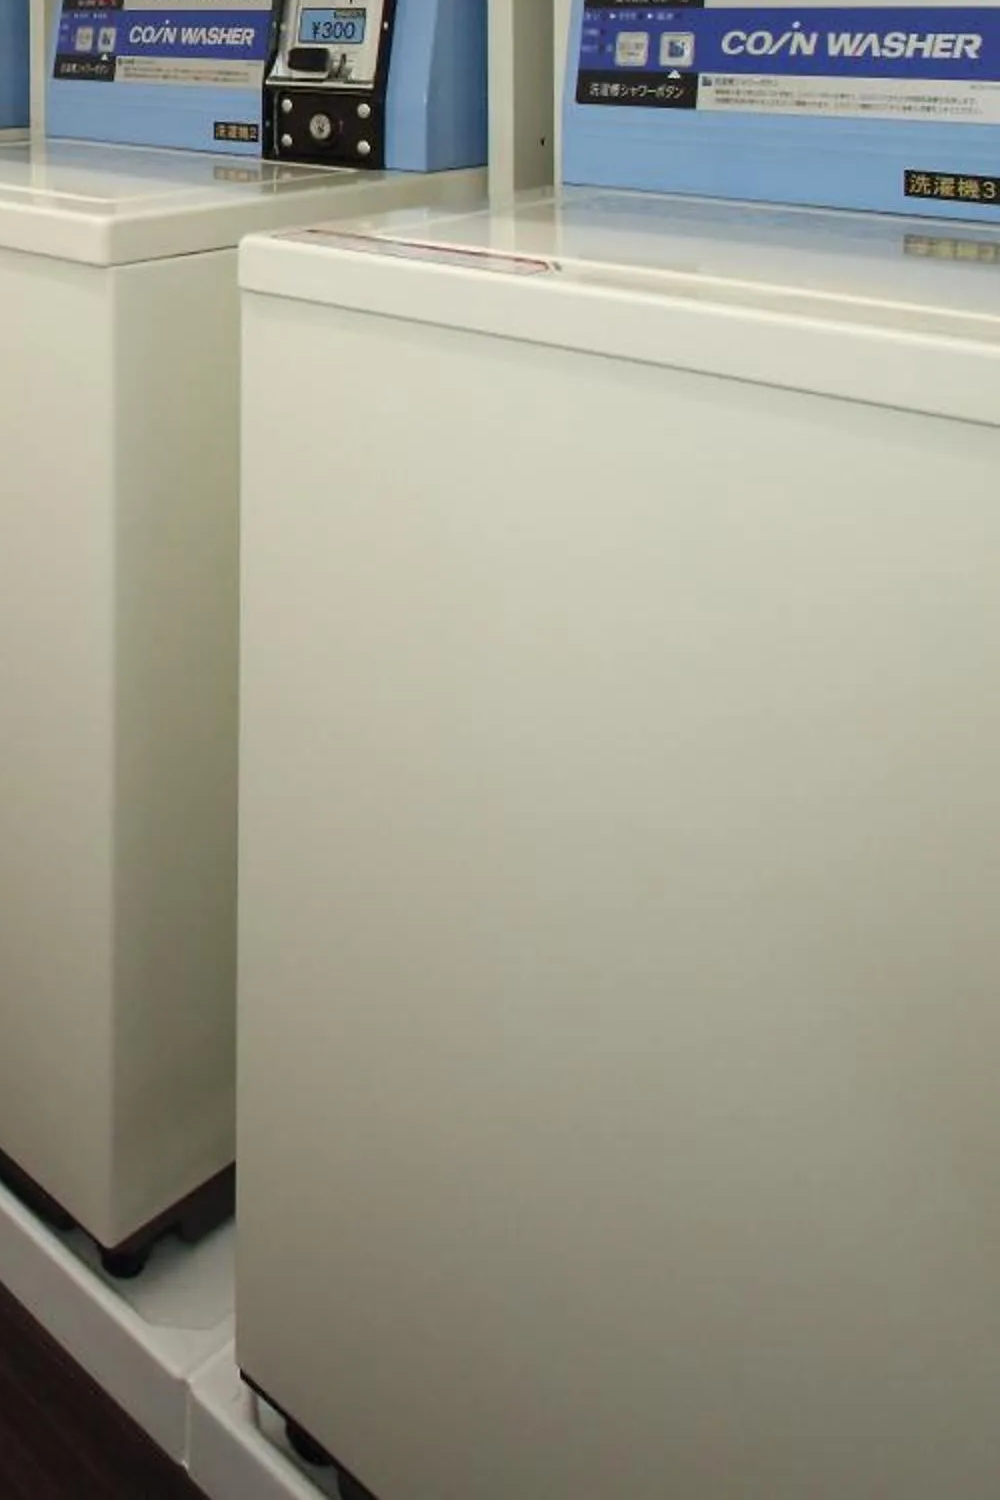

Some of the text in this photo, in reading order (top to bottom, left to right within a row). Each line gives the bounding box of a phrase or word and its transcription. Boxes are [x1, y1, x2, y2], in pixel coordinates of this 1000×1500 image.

[129, 19, 256, 47] COIN WASHER
[311, 20, 356, 40] ¥300
[721, 20, 983, 60] COIN WASHER
[908, 172, 997, 199] 洗濯機3
